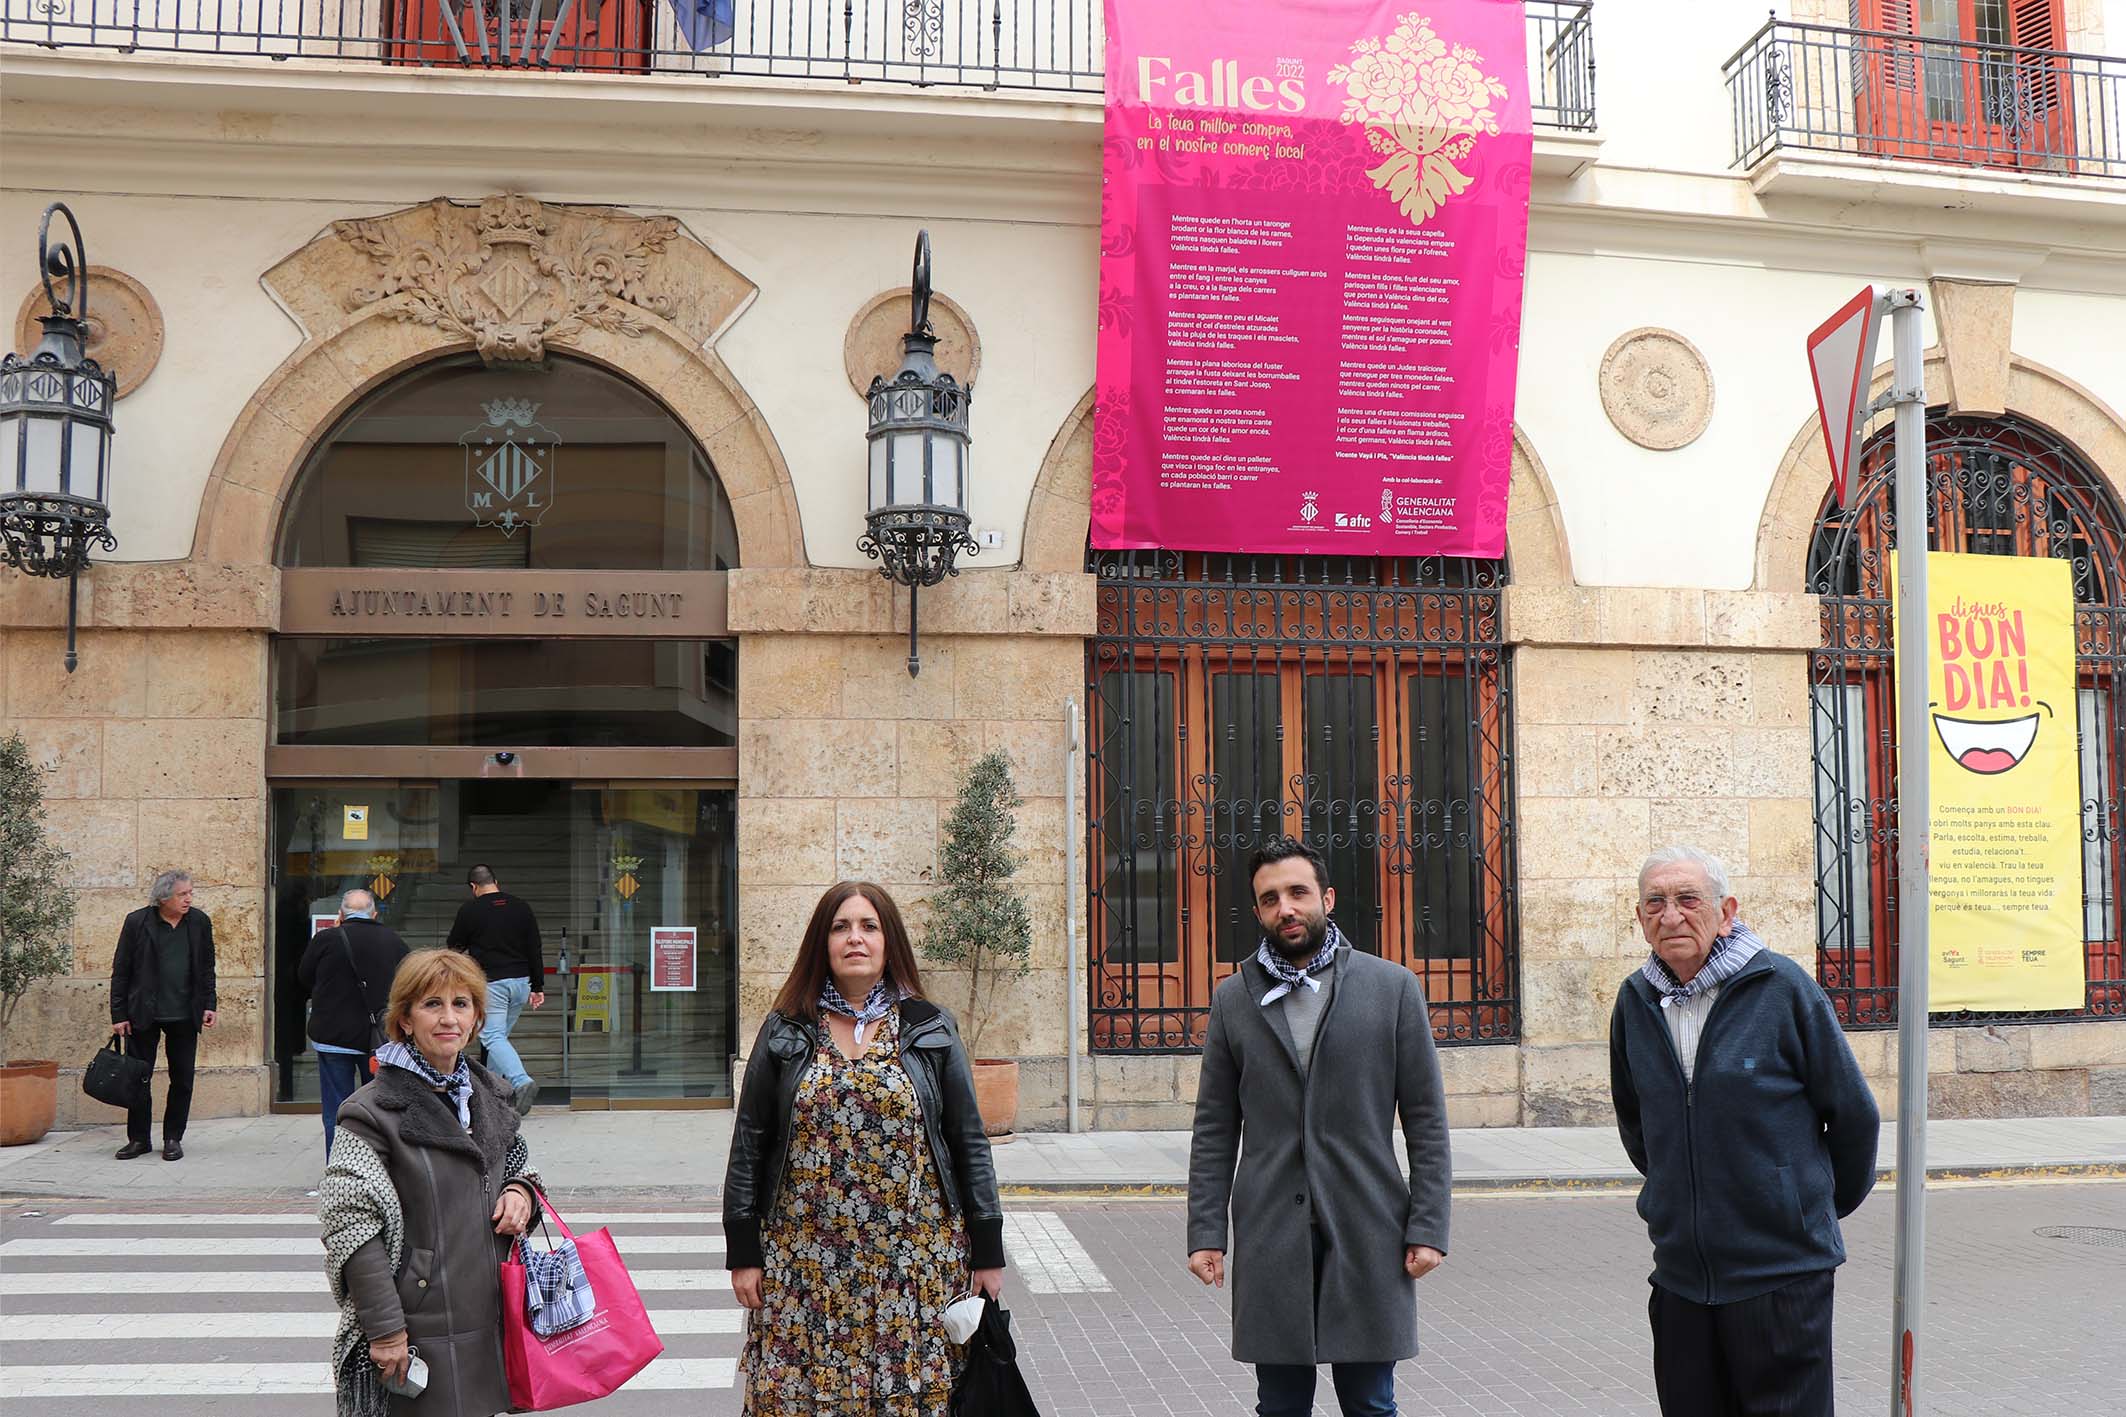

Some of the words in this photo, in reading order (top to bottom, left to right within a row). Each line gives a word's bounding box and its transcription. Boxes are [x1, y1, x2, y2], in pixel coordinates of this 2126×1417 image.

[1276, 63, 1304, 78] 2022
[1138, 56, 1306, 112] Falles
[1149, 114, 1161, 129] La
[1167, 113, 1194, 131] teua
[1200, 117, 1237, 134] millor
[1243, 123, 1294, 139] compra,
[1137, 137, 1153, 150] en
[1160, 136, 1170, 151] el
[1176, 136, 1217, 153] nostre
[1224, 142, 1270, 160] comerç
[1276, 143, 1304, 160] local
[1172, 215, 1199, 223] Mentres
[1200, 216, 1221, 226] quede
[1263, 219, 1291, 228] taronger
[1171, 225, 1197, 233] brodant
[1227, 227, 1249, 235] blanca
[1171, 234, 1198, 243] mentres
[1199, 237, 1228, 246] nasquen
[1229, 237, 1257, 245] baladres
[1262, 238, 1282, 246] llorers
[1343, 314, 1369, 322] Mentres
[1370, 315, 1406, 326] seguisquen
[1406, 317, 1430, 327] onejant
[1342, 325, 1370, 333] senyeres
[1371, 326, 1382, 334] per
[1390, 326, 1414, 334] història
[1342, 333, 1368, 341] mentres
[1376, 334, 1386, 342] sol
[1167, 358, 1193, 366] Mentres
[1202, 360, 1220, 369] plana
[1221, 360, 1252, 368] laboriosa
[1252, 361, 1263, 369] del
[1166, 369, 1195, 378] arranque
[1204, 369, 1221, 377] fusta
[1222, 370, 1246, 378] deixant
[1258, 371, 1300, 380] borrumballes
[1173, 378, 1192, 386] tindre
[1206, 388, 1216, 396] les
[473, 493, 492, 507] M
[527, 493, 542, 507] L
[1397, 498, 1456, 506] GENERALITAT
[1397, 508, 1453, 516] VALENCIANA
[1350, 514, 1371, 527] afic
[330, 590, 513, 617] AJUNTAMENT
[534, 591, 566, 617] DE
[585, 592, 683, 618] SAGUNT
[1952, 596, 2007, 619] digues
[1938, 611, 2026, 660] BON
[1944, 659, 2031, 711] DIA!
[1939, 805, 1975, 815] Comença
[1974, 821, 1996, 829] panys
[1934, 833, 1955, 842] Parla,
[1958, 834, 1985, 842] escolta,
[1989, 834, 2016, 842] estima,
[2019, 834, 2049, 842] treballa,
[1952, 848, 1982, 856] estudia,
[1973, 875, 2013, 884] l'amagues,
[2027, 876, 2054, 884] tingues
[1935, 904, 1961, 912] perquè
